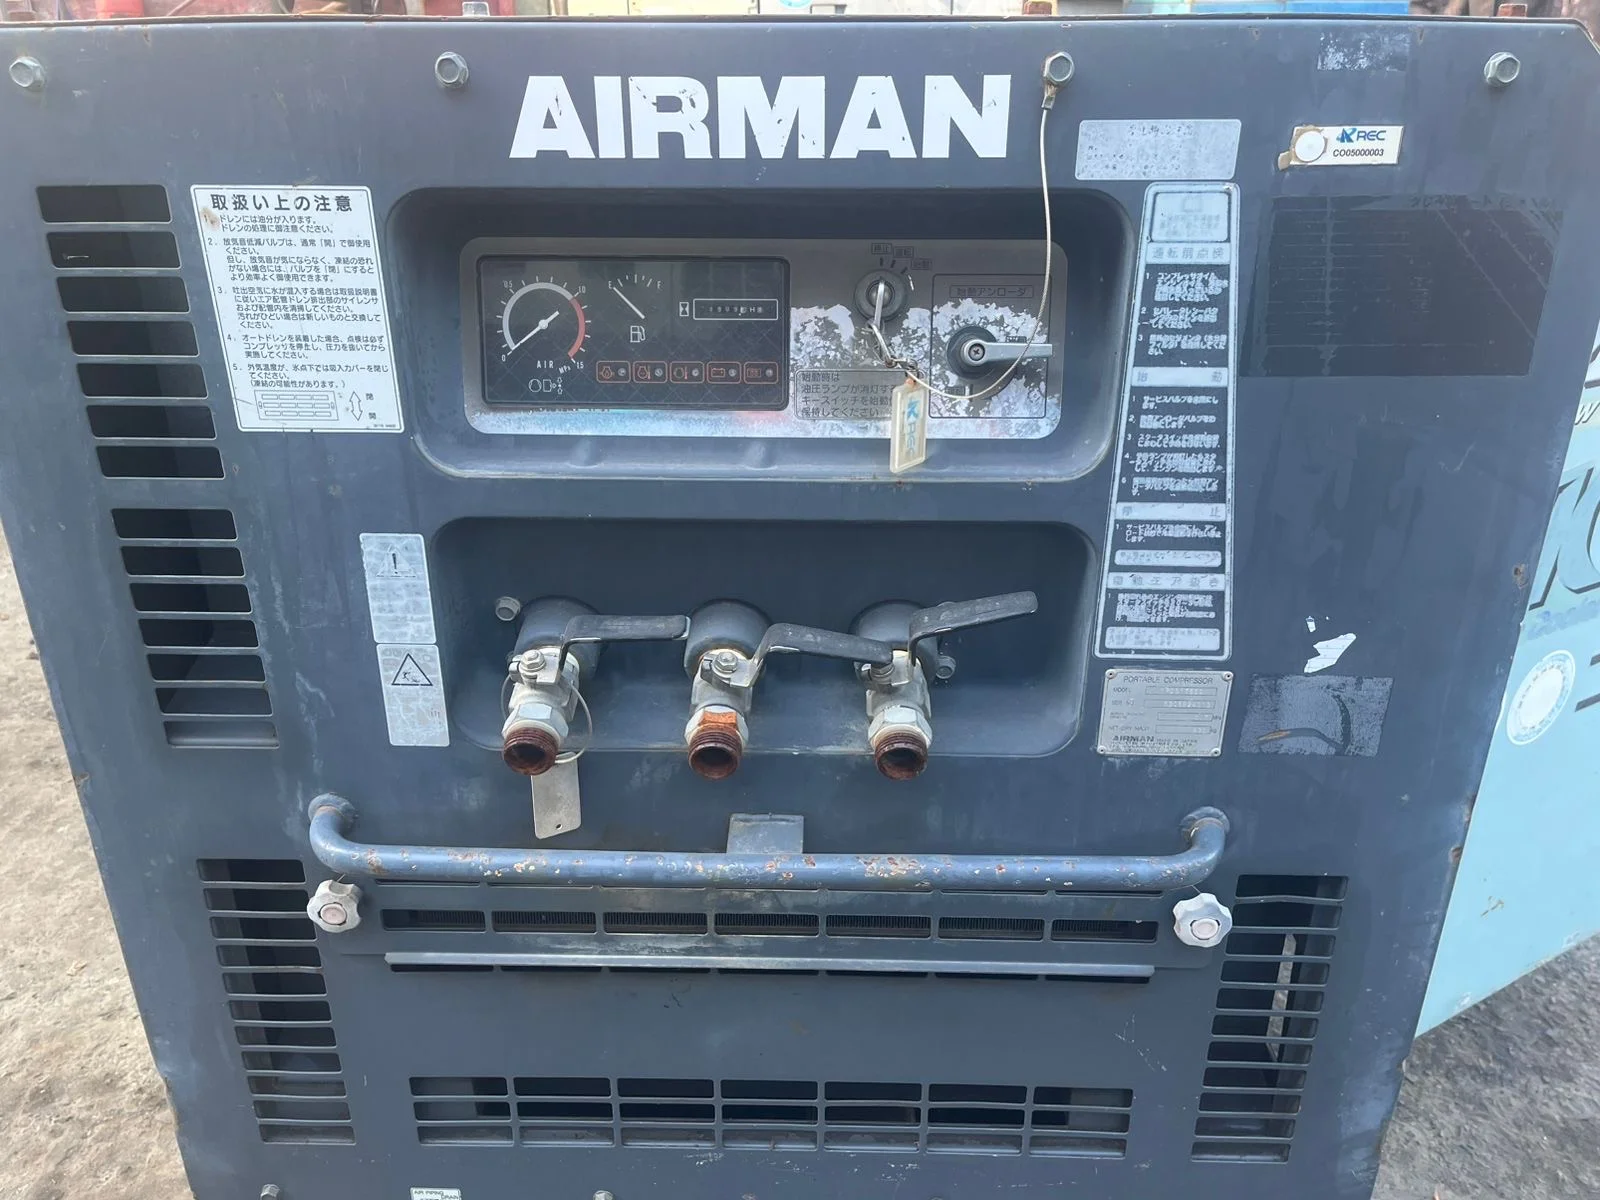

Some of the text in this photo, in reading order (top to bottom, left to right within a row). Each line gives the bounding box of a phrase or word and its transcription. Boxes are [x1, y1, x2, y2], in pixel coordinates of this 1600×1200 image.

[509, 75, 1011, 159] AIRMAN
[210, 193, 353, 212] 取扱い上の注意
[225, 247, 260, 256] ください。
[239, 321, 274, 330] ください。
[536, 360, 554, 369] AIR
